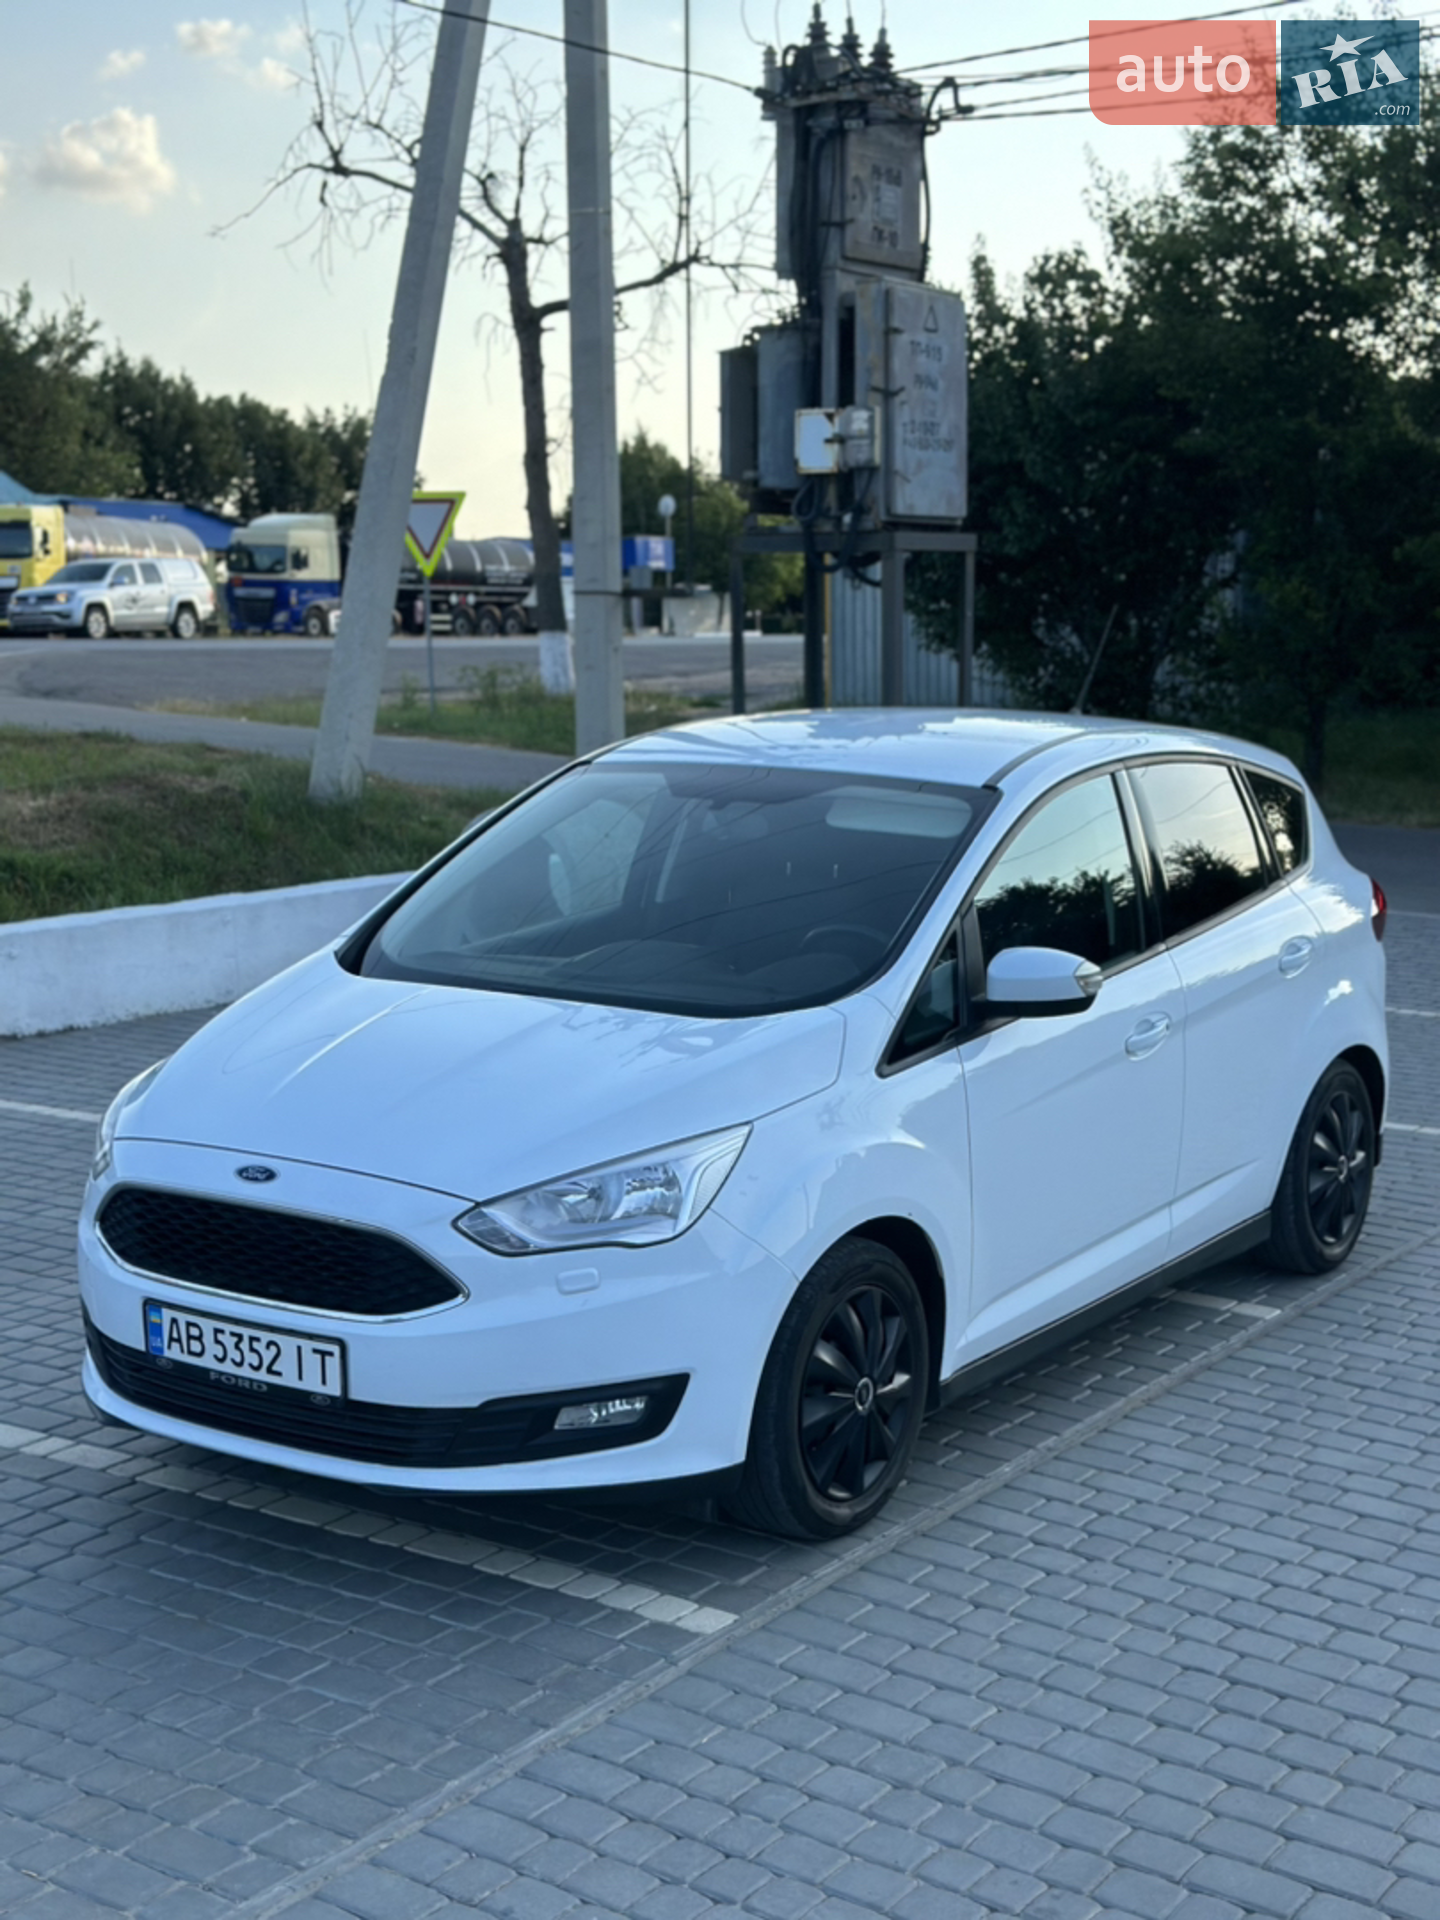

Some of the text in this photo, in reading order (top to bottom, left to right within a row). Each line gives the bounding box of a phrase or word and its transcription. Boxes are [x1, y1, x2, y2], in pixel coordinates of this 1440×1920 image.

[167, 1317, 335, 1387] AB 5352 IT
[209, 1371, 268, 1393] FORD
